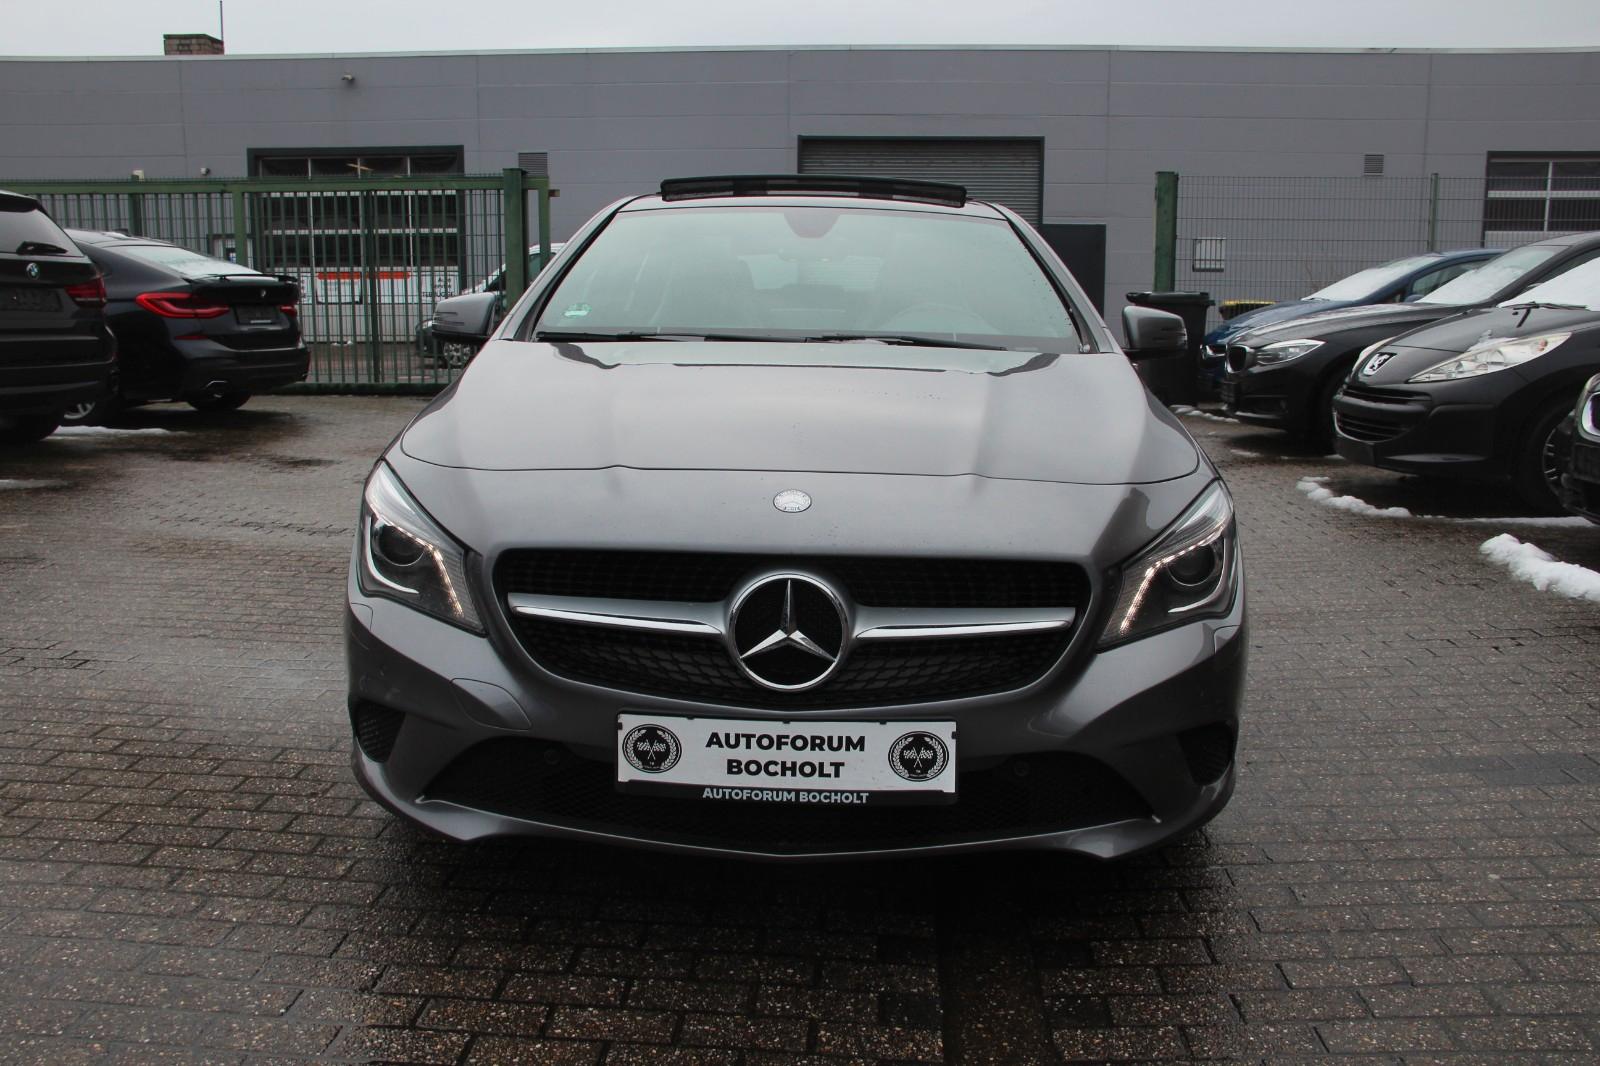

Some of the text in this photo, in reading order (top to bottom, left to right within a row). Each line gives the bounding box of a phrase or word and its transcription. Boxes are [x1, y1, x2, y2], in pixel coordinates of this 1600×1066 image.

[705, 731, 866, 752] AUTOFORUM
[727, 758, 845, 779] BOCHOLT
[703, 787, 869, 804] AUTOFORUM BOCHOLT
